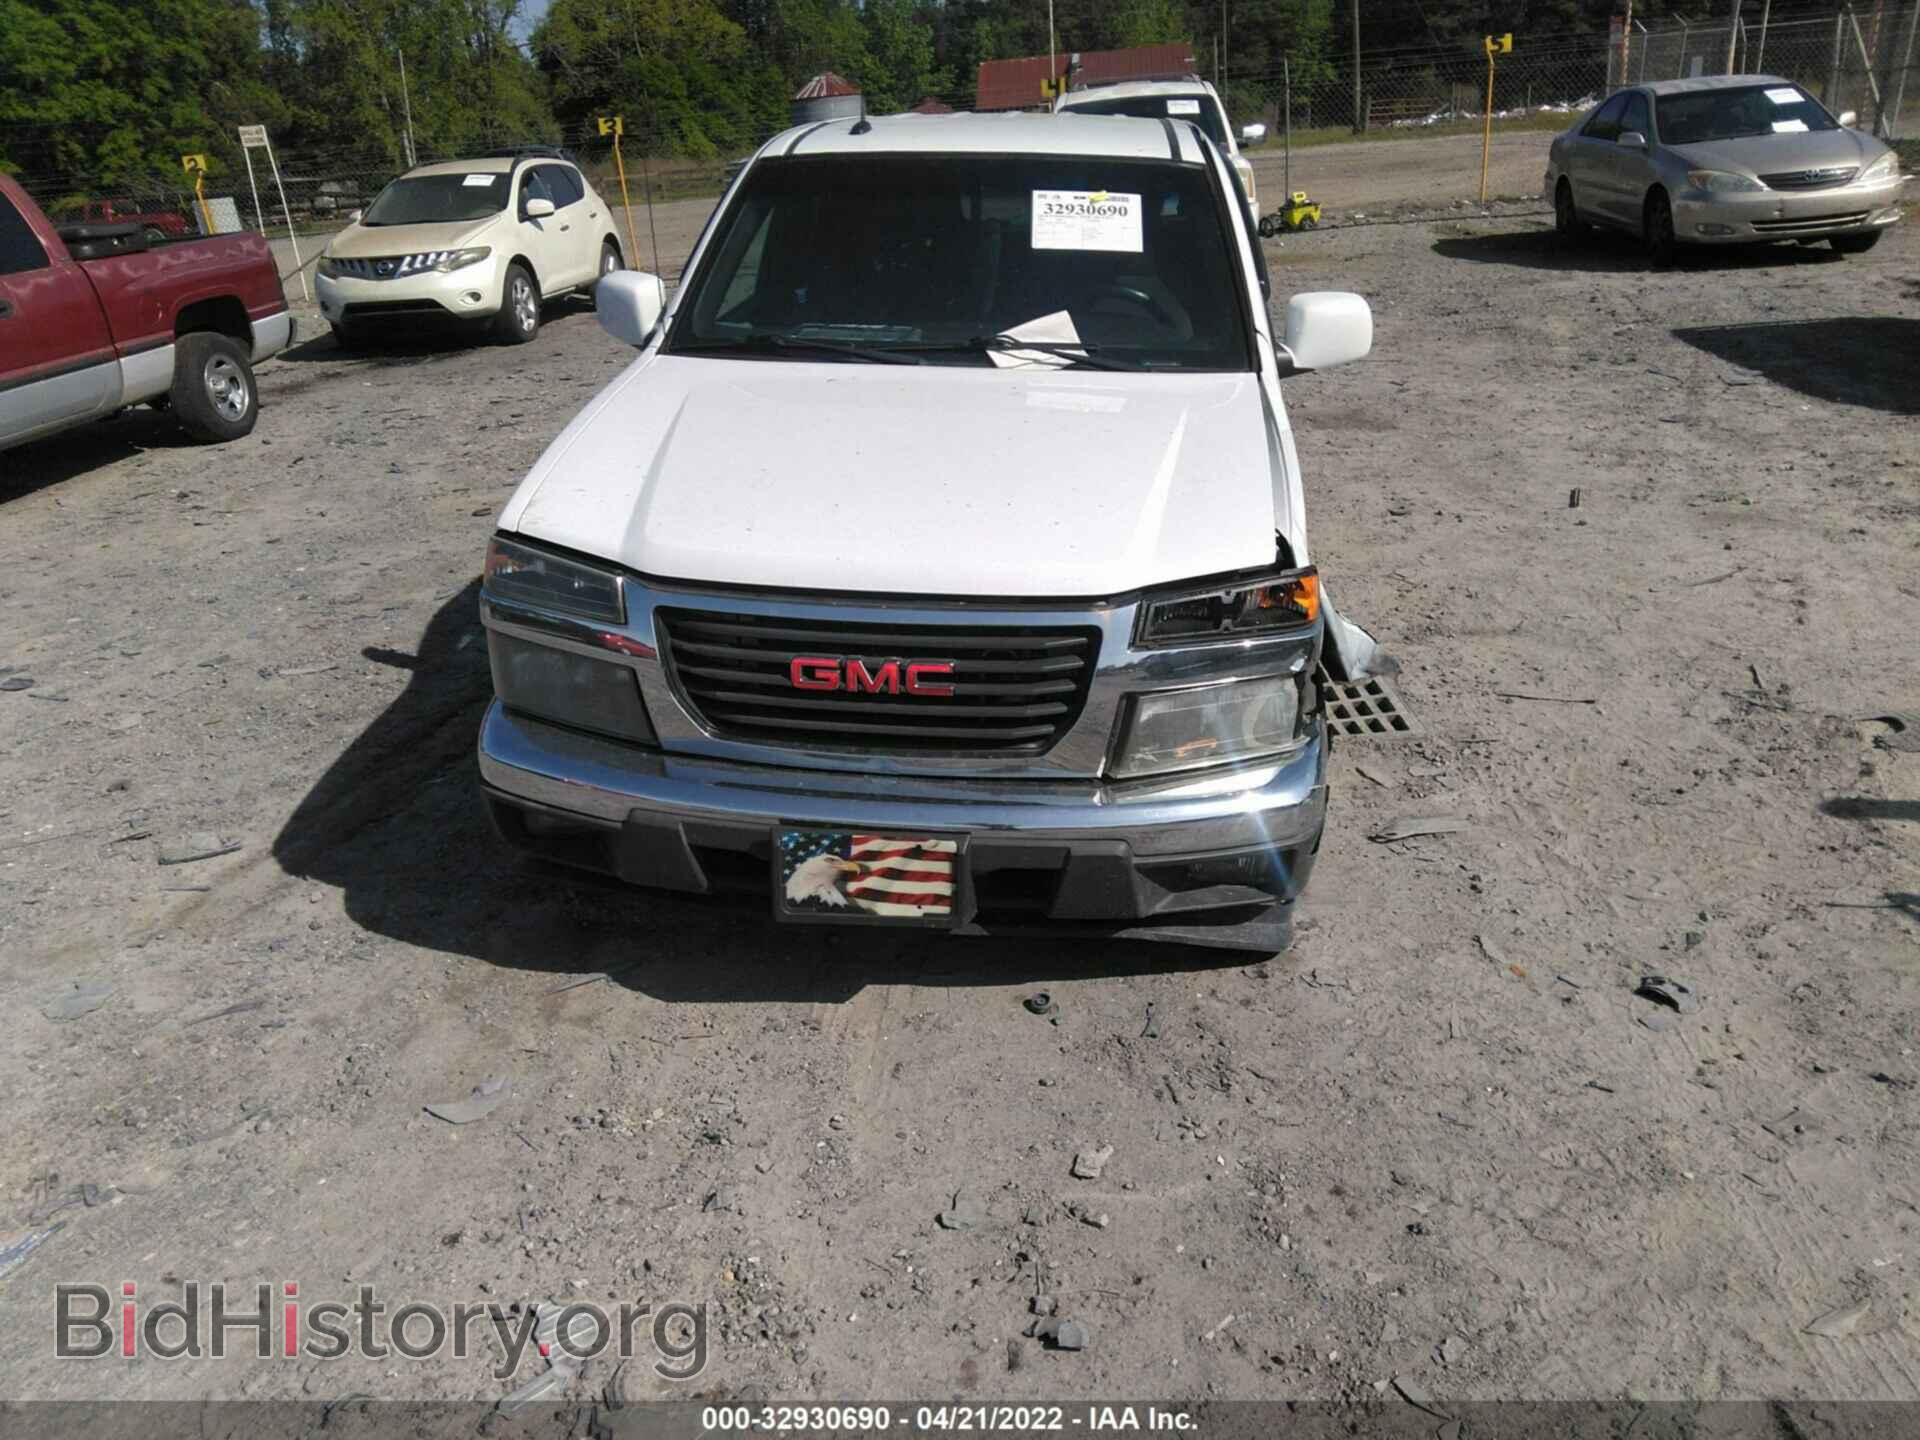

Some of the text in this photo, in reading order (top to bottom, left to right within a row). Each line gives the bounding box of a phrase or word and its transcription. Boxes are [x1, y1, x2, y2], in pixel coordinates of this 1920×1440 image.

[603, 117, 617, 135] 3
[187, 157, 204, 173] 2
[1043, 203, 1128, 217] 32930690
[790, 656, 955, 696] GMC
